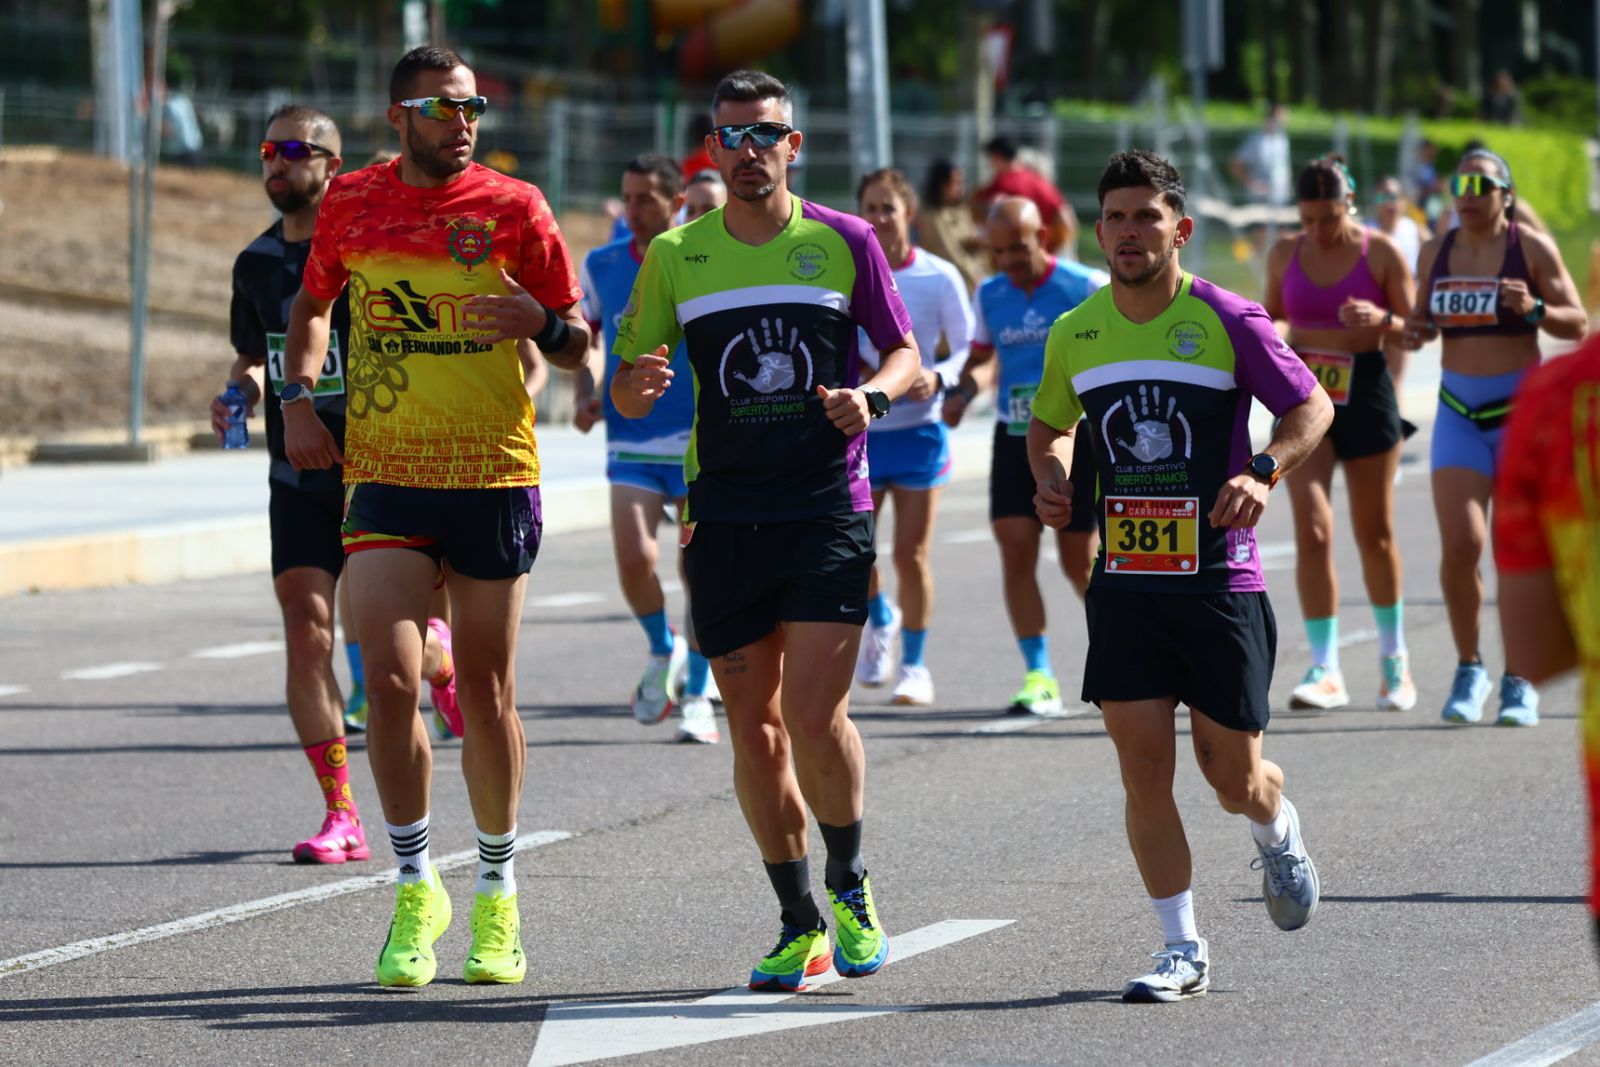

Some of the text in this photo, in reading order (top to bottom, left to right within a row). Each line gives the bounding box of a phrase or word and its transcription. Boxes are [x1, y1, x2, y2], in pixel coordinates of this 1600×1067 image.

[1435, 293, 1493, 313] 1807
[754, 394, 804, 403] DEPORTIVO
[731, 402, 805, 417] ROBERTO RAMOS
[728, 414, 804, 425] FISIOTERAPIA
[381, 463, 409, 474] VICTORIA
[411, 464, 450, 475] FORTALEZA
[453, 463, 482, 474] LEALTAD
[493, 463, 513, 473] VALOR
[1115, 462, 1186, 473] CLUB DEPORTIVO
[458, 474, 480, 483] VALOR
[1114, 471, 1188, 486] ROBERTO RAMOS
[1114, 484, 1190, 493] FISIOTERAPIA
[1128, 508, 1170, 516] CARRERA
[1118, 519, 1178, 552] 381
